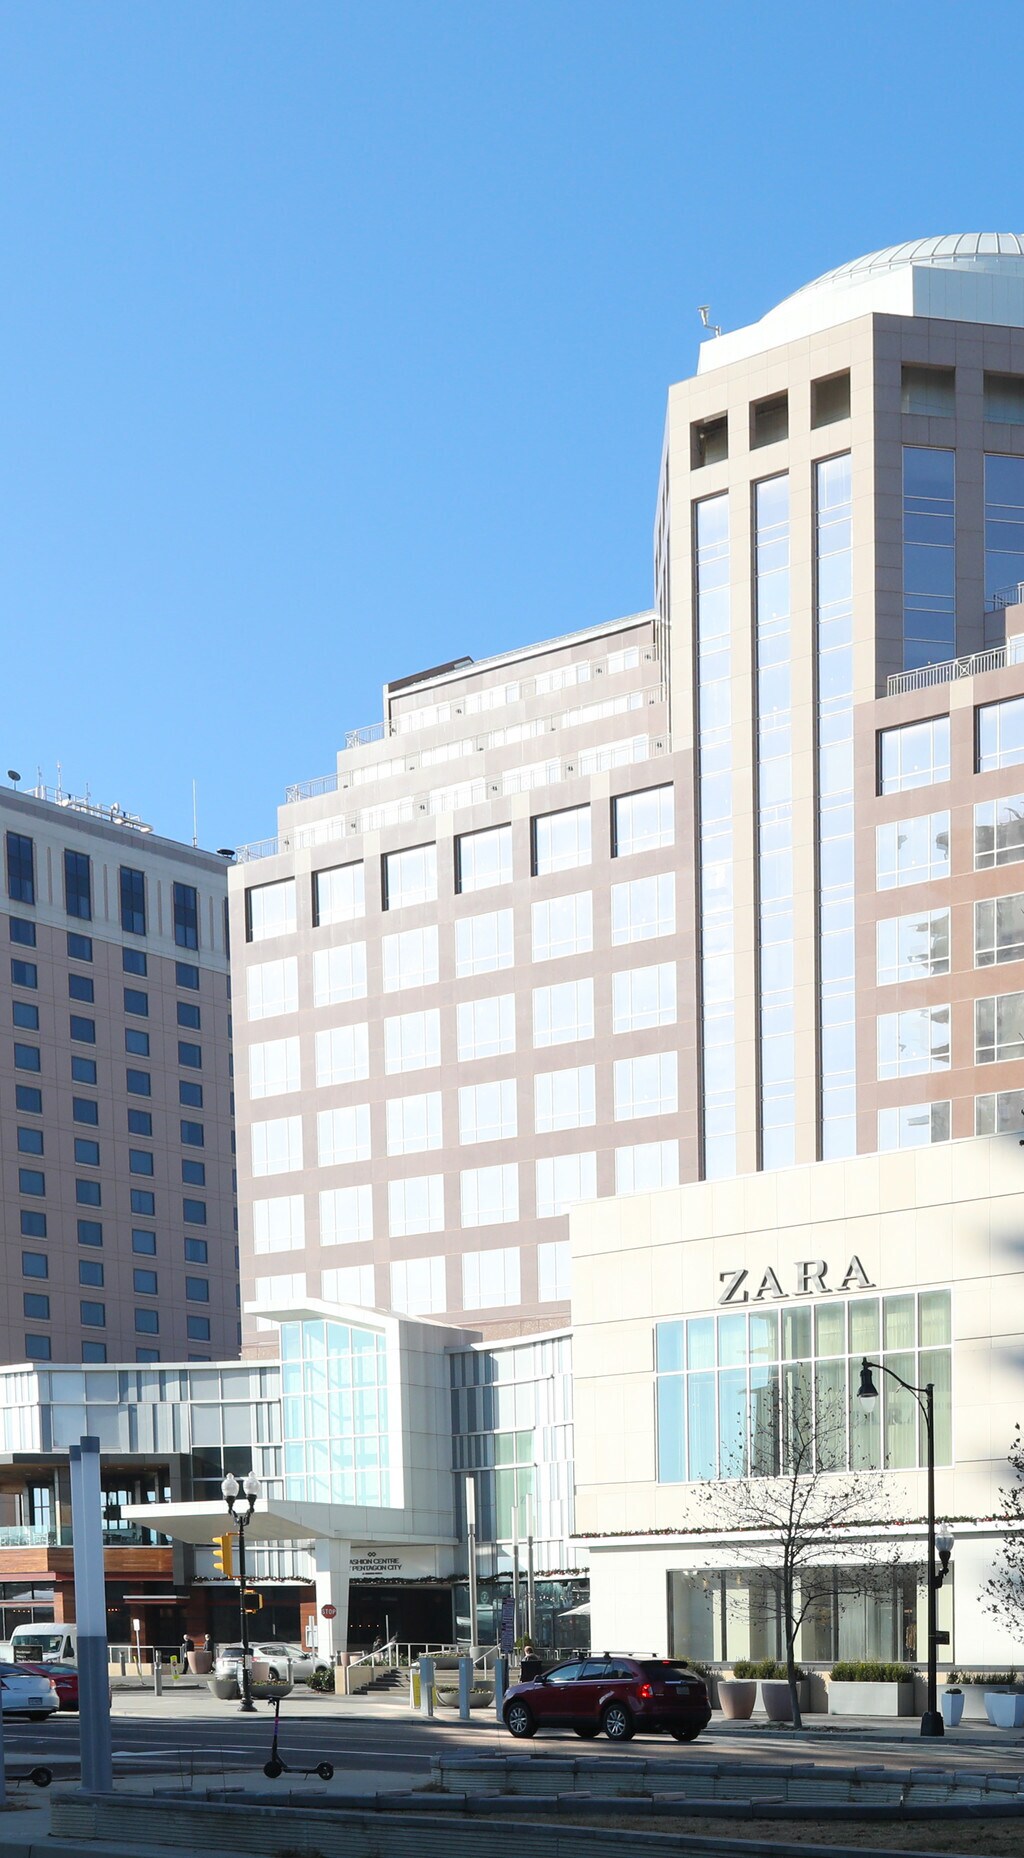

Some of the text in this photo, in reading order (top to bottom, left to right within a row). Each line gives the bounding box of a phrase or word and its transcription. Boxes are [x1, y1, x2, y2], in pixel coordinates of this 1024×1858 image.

[717, 1254, 877, 1305] ZARA
[373, 1557, 400, 1565] CENTRE
[352, 1564, 387, 1572] PENTAGON
